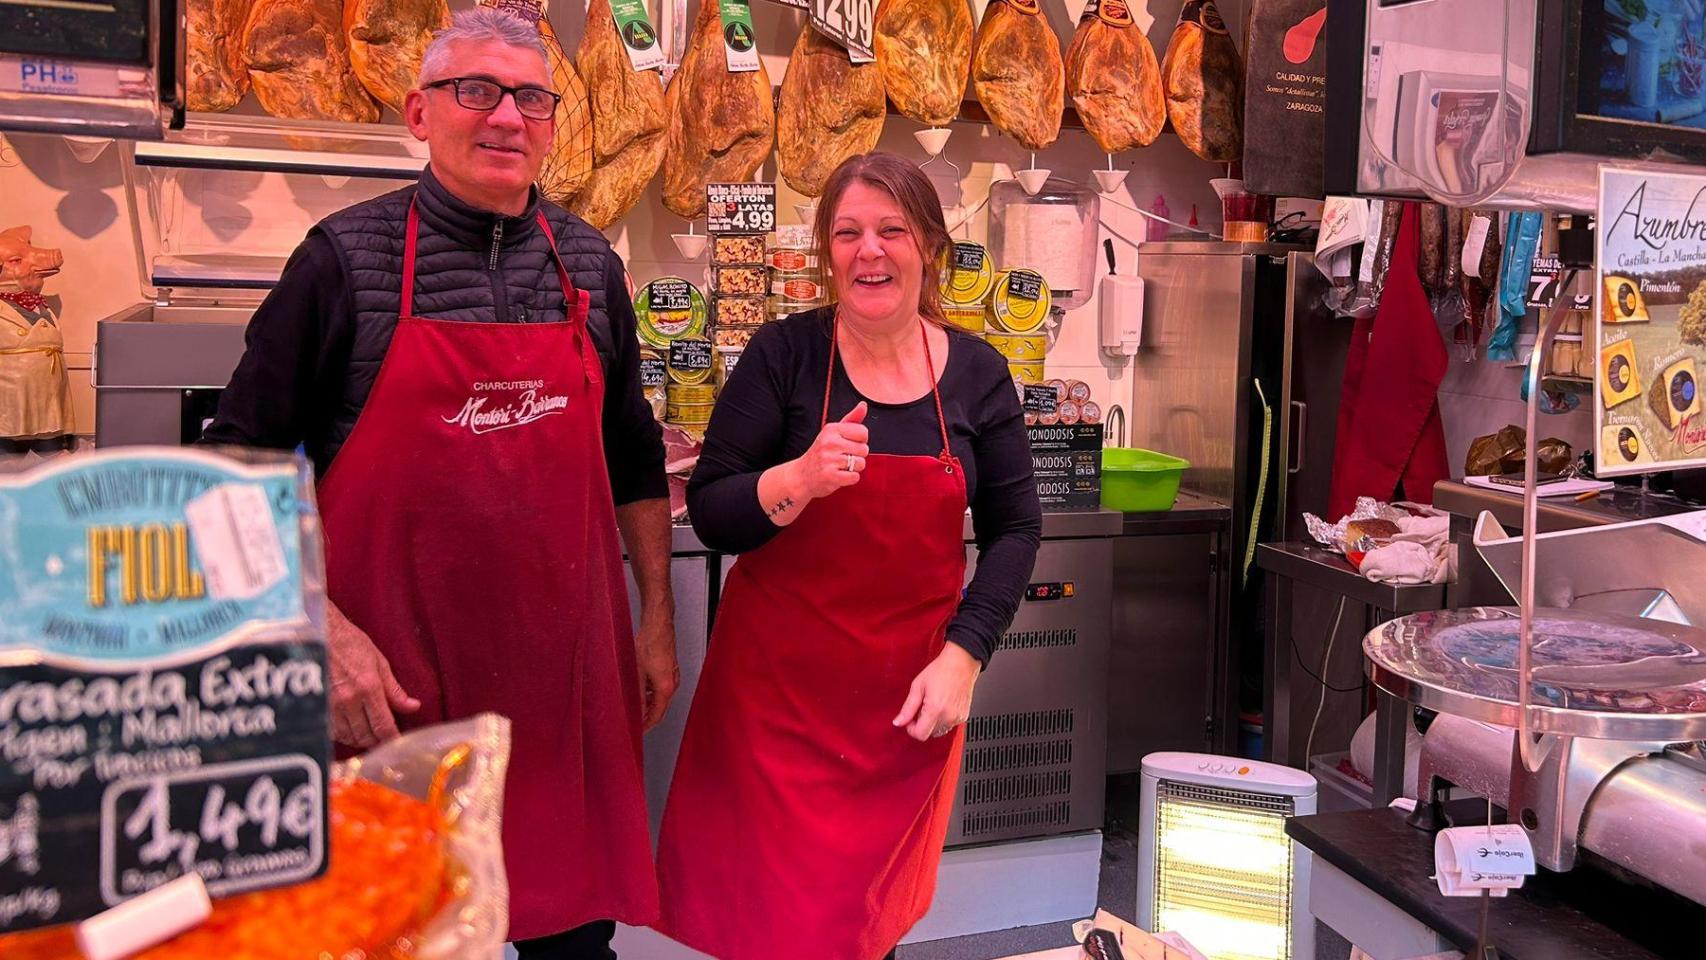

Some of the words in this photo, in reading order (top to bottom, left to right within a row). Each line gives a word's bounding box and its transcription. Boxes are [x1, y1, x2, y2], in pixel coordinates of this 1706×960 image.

[22, 63, 56, 82] PH
[1276, 72, 1305, 82] CALIDAD
[1306, 75, 1311, 83] Y
[1286, 102, 1323, 113] ZARAGOZA
[710, 195, 766, 203] OFERTON
[727, 202, 736, 212] 3
[738, 204, 774, 212] LATAS
[732, 212, 774, 231] 4,99
[1618, 250, 1649, 267] Castilla
[1659, 251, 1670, 264] La
[1674, 245, 1706, 262] Mancha
[1640, 278, 1681, 292] Pimentón
[473, 379, 544, 391] CHARCUTERIAS
[200, 654, 324, 706] Extra
[124, 774, 316, 868] 1,49€
